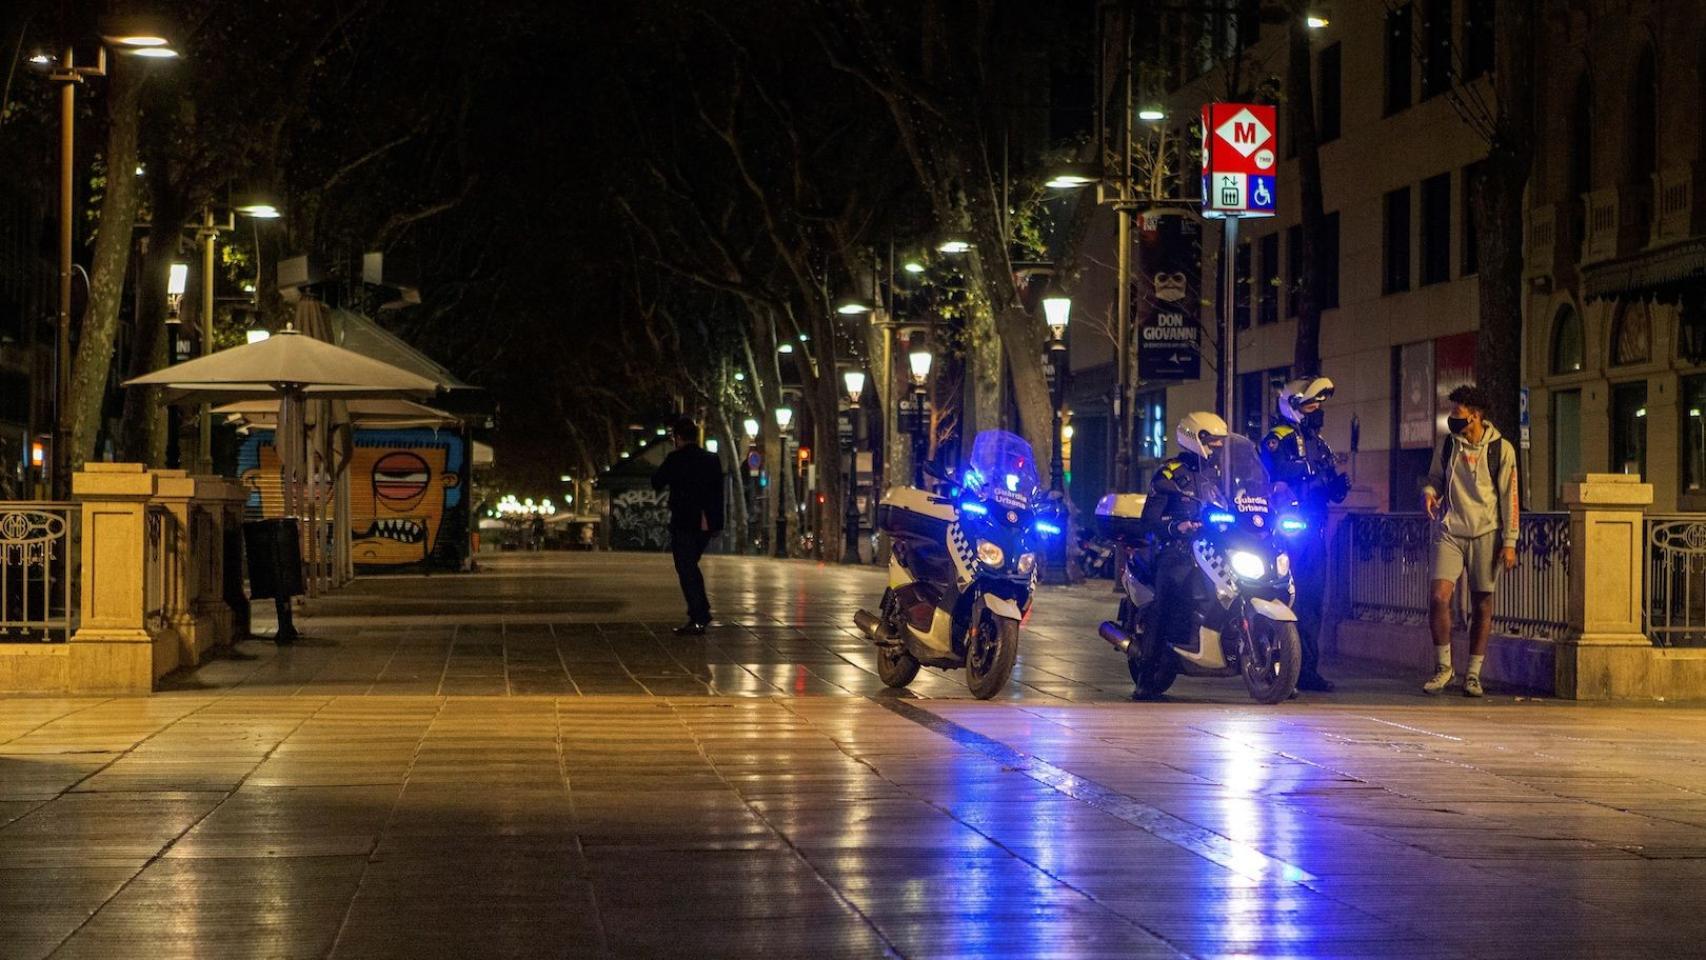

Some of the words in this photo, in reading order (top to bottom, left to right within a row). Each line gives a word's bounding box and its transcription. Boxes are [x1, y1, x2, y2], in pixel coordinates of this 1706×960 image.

[1234, 122, 1256, 144] M
[1157, 313, 1184, 326] DON
[1143, 327, 1197, 340] GIOVANNI
[994, 488, 1027, 503] Guardia
[1234, 495, 1267, 505] Guardia
[995, 496, 1026, 510] Urbana
[1238, 504, 1268, 513] Urbana
